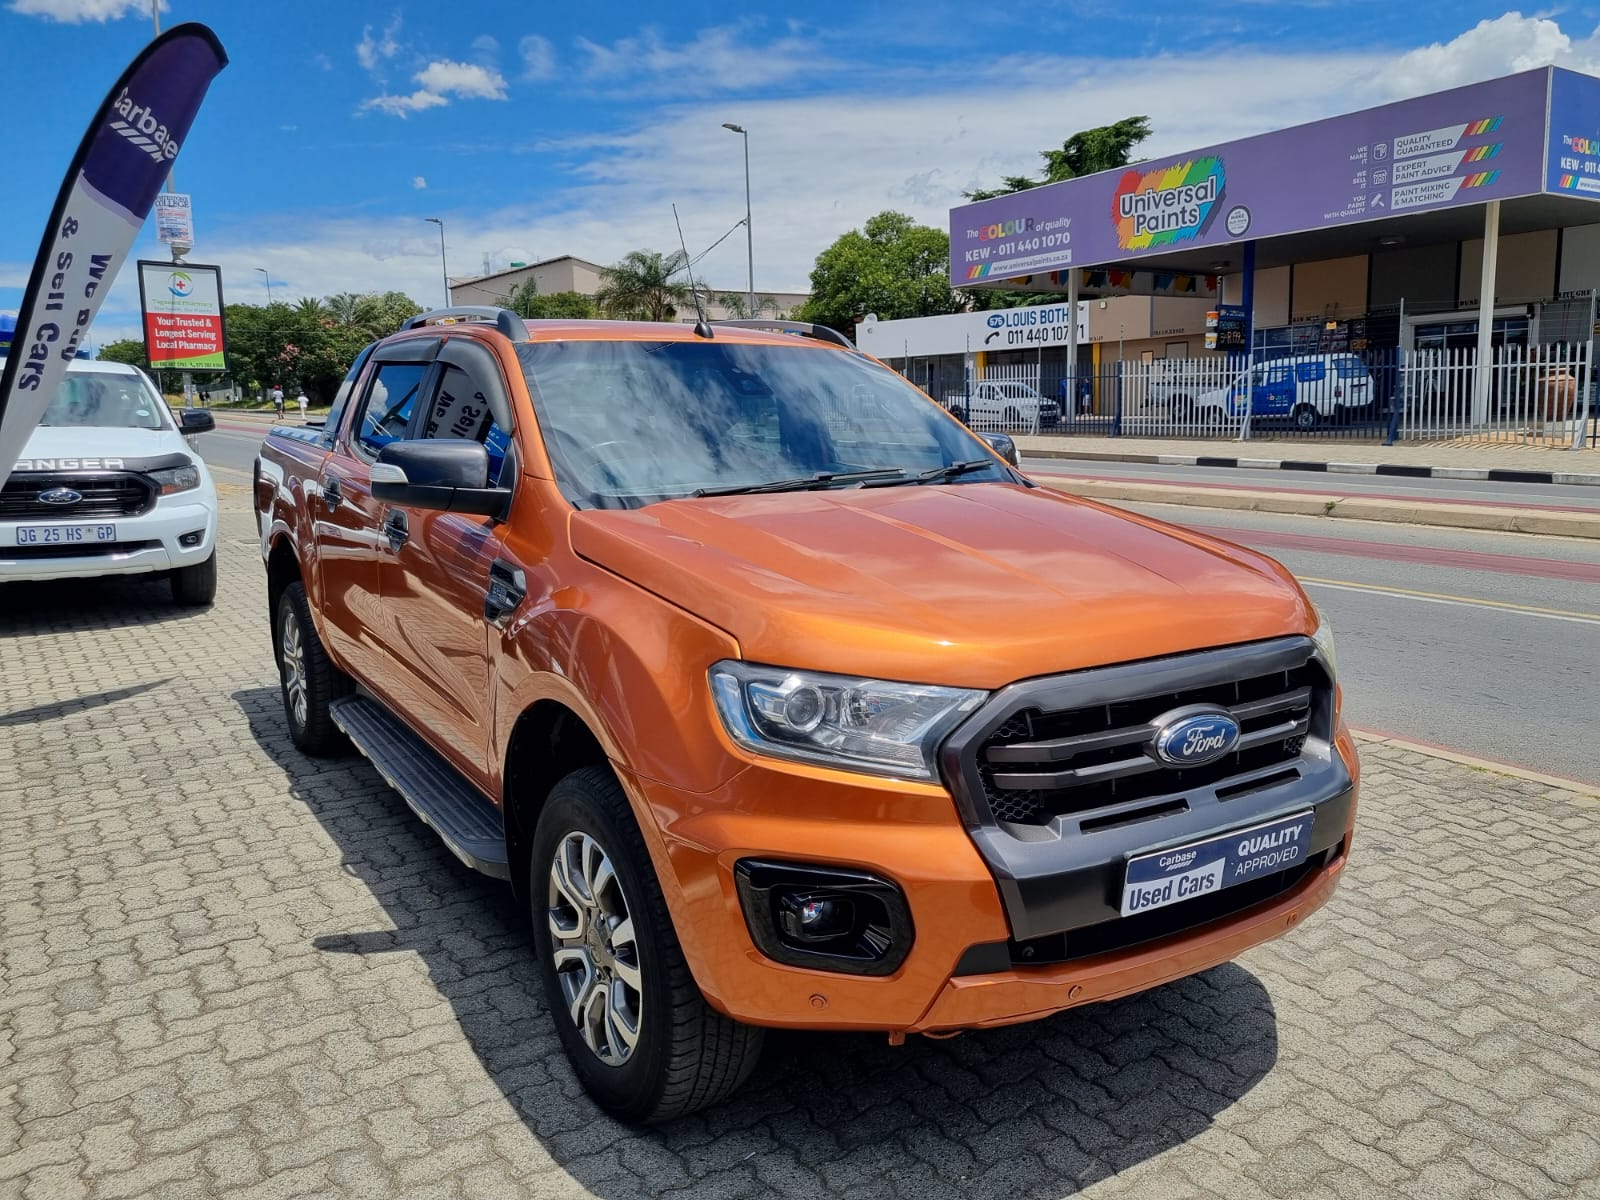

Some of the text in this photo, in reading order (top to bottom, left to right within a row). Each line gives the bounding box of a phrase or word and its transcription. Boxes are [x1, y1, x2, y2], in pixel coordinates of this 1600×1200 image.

[114, 86, 178, 159] Carbae
[1357, 145, 1368, 153] WE
[1396, 134, 1431, 148] QUALITY
[1396, 138, 1453, 155] GUARANTEED
[1563, 135, 1600, 157] The COLO
[1349, 152, 1368, 160] MAKE
[1395, 161, 1427, 173] EXPERT
[1395, 165, 1452, 181] PAINT ADVICE
[1560, 156, 1579, 171] KEW
[1584, 161, 1597, 174] 011
[1352, 177, 1366, 185] SELL
[1121, 178, 1215, 215] Universal
[1394, 182, 1450, 198] PAINT MIXING
[1401, 192, 1445, 204] MATCHING
[1340, 207, 1366, 217] QUALITY
[1347, 201, 1366, 209] PAINT
[1136, 206, 1198, 234] Paints
[966, 217, 1071, 241] The COLOUR of quality
[965, 247, 991, 262] KEW
[998, 242, 1015, 255] 011
[1017, 238, 1039, 252] 440
[1042, 232, 1070, 248] 1070
[18, 216, 78, 391] & Sell Cars
[157, 317, 174, 326] Your
[176, 318, 204, 327] Trusted
[1006, 311, 1036, 327] LOUIS
[1040, 308, 1069, 324] BOTH
[155, 328, 216, 340] Longest Serving
[1008, 329, 1023, 344] 011
[1027, 328, 1048, 342] 440
[157, 340, 217, 351] Local Pharmacy
[12, 459, 124, 470] ANGER
[20, 527, 113, 543] JG 25 HS GP
[1183, 725, 1225, 756] Ford
[1237, 825, 1302, 856] QUALITY
[1159, 850, 1197, 868] Carbase
[1235, 846, 1299, 877] APPROVED
[1129, 872, 1215, 910] Used Cars
